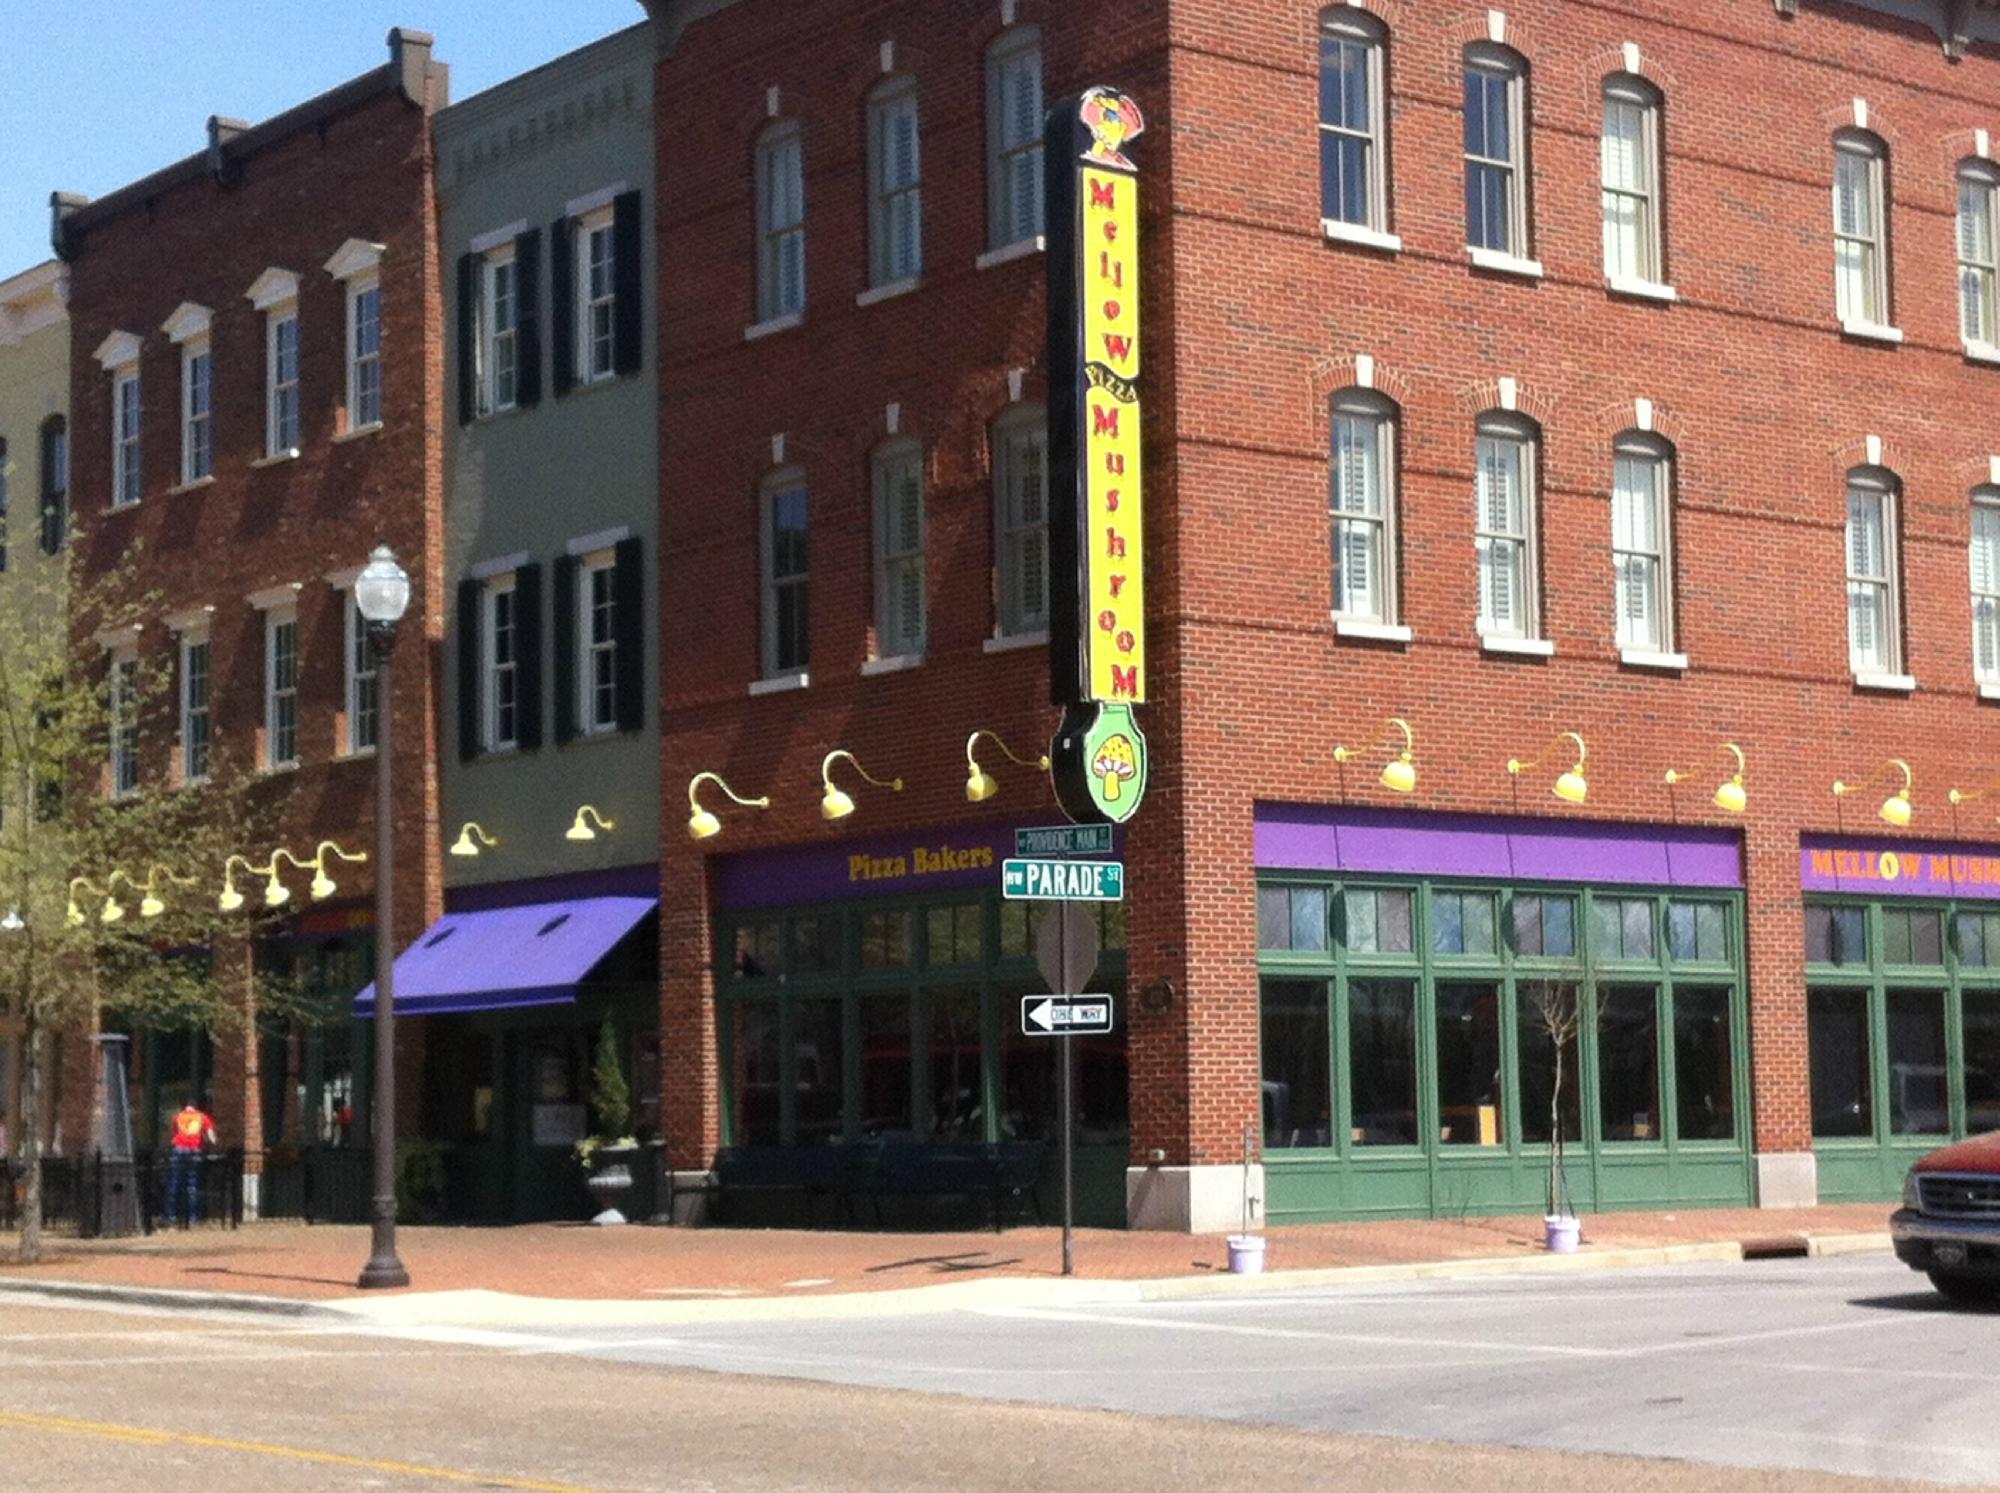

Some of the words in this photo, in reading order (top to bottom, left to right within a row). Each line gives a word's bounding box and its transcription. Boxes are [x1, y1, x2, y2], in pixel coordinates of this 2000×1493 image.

[1085, 365, 1137, 401] PIZZA
[849, 854, 906, 881] Pizza
[913, 846, 993, 874] Bakers
[1811, 849, 1922, 880] MELLOW
[1027, 864, 1104, 896] PARADE
[1107, 867, 1120, 880] ST
[1051, 1007, 1074, 1021] ONE
[1080, 1007, 1102, 1020] WAY
